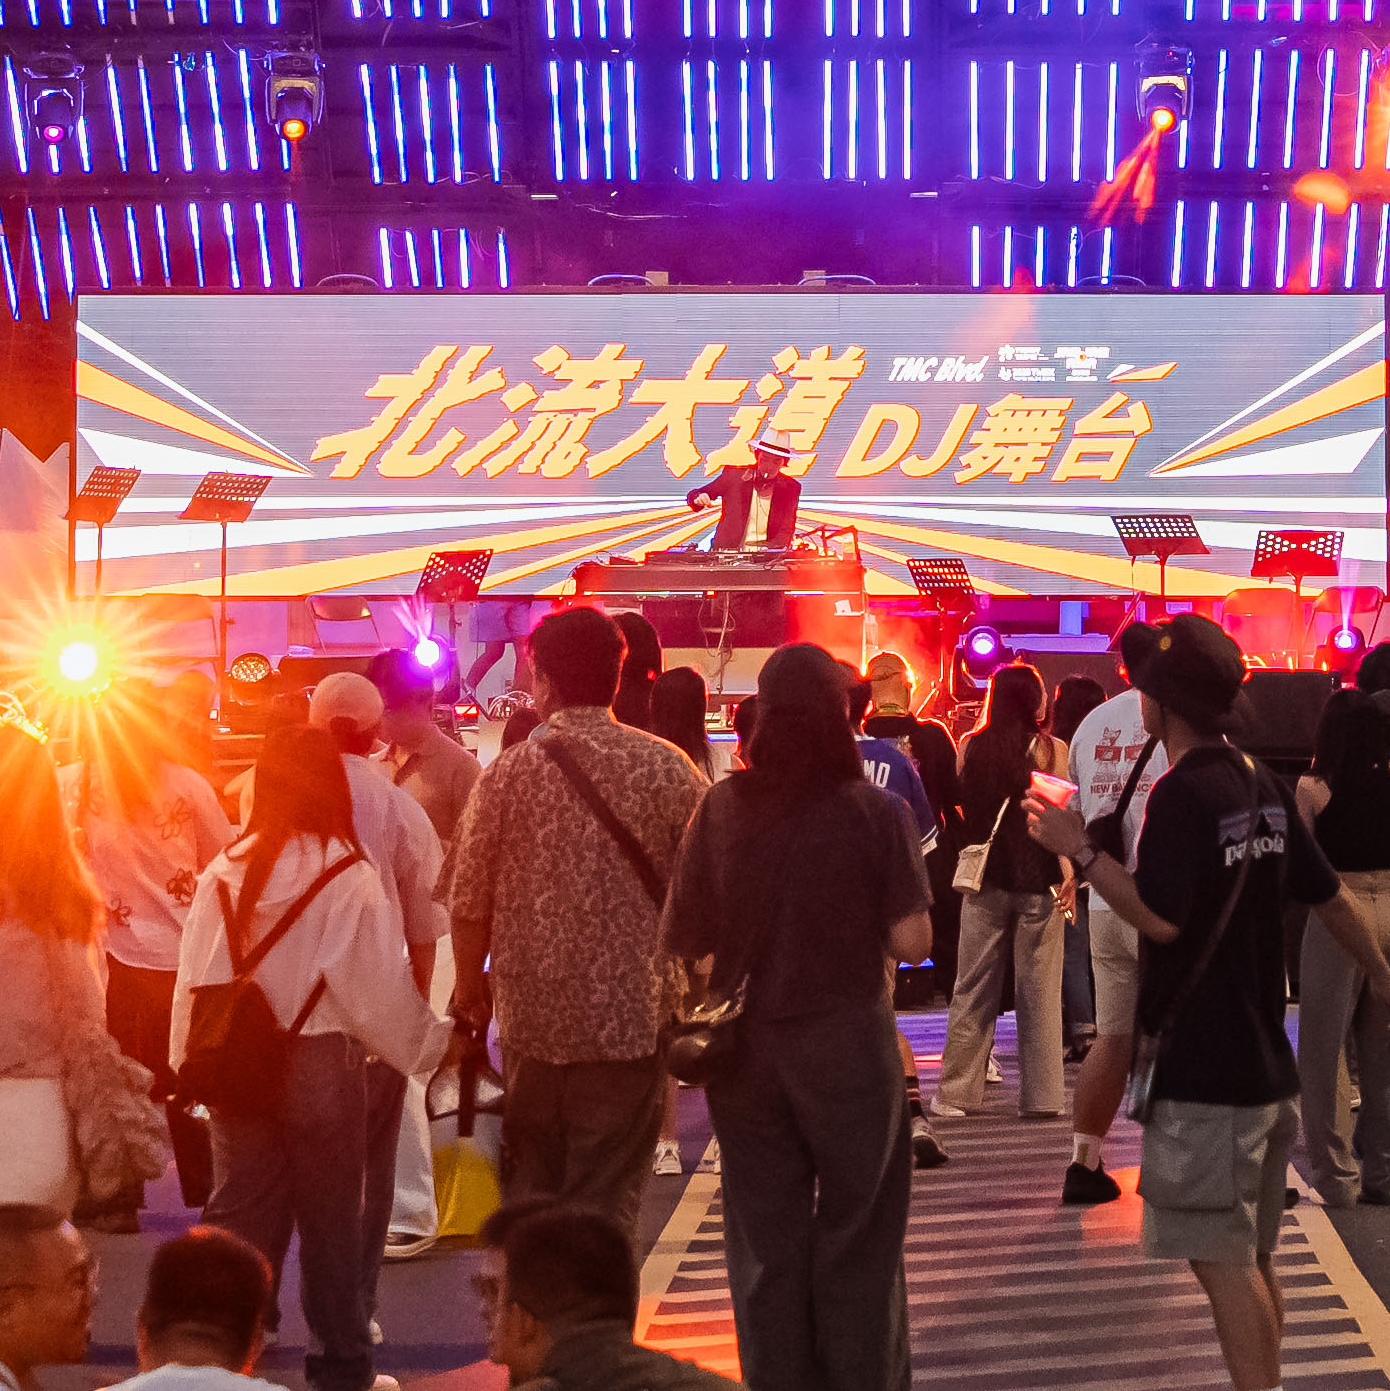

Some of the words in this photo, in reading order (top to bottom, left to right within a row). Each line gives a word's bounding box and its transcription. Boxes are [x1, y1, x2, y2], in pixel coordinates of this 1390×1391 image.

[888, 357, 939, 382] TMC
[309, 343, 868, 479] 北流大道
[835, 390, 1154, 485] DJ舞台
[1090, 784, 1110, 794] NEW
